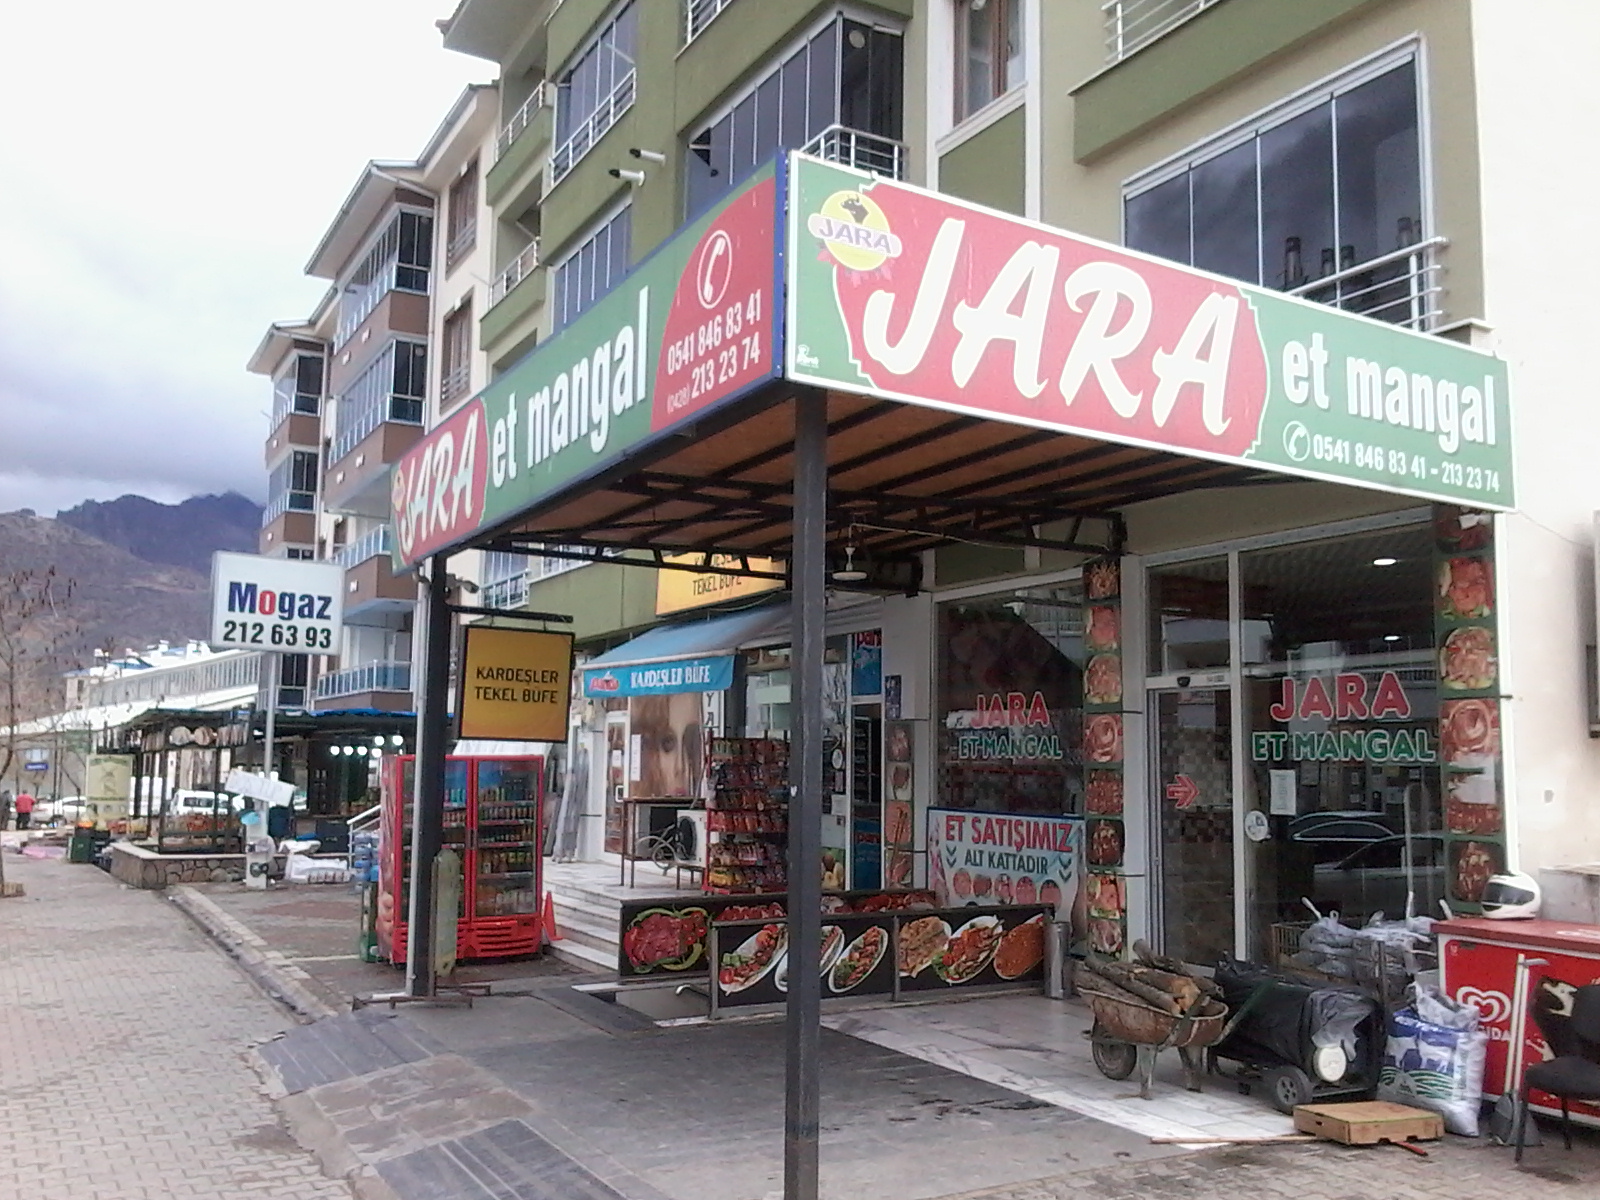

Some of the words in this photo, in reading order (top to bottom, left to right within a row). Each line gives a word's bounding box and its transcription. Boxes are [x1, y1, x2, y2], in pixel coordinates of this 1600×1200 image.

[819, 218, 892, 254] JARA
[668, 332, 695, 375] 0541
[698, 314, 722, 357] 846
[725, 301, 742, 339] 83
[746, 288, 761, 325] 41
[862, 217, 1240, 436] JARA
[1282, 332, 1330, 410] et
[1346, 356, 1497, 454] mangal
[691, 358, 715, 399] 213
[719, 345, 737, 384] 23
[741, 331, 760, 370] 74
[401, 408, 479, 556] JARA
[492, 390, 518, 488] et
[527, 285, 649, 470] mangal
[1313, 434, 1350, 465] 0541
[1355, 442, 1384, 471] 846
[1388, 449, 1407, 475] 83
[1411, 455, 1426, 480] 41
[1441, 461, 1463, 486] 213
[1466, 466, 1482, 490] 23
[1485, 469, 1500, 493] 74
[228, 581, 333, 621] Mogaz
[223, 620, 264, 645] 212
[271, 623, 298, 646] 63
[305, 626, 331, 649] 93
[476, 666, 559, 685] KARDEŞLER
[475, 686, 517, 702] TEKEL
[522, 687, 558, 704] BÜFE
[971, 691, 1050, 729] JARA
[1270, 671, 1411, 722] JARA
[958, 736, 979, 760] ET
[981, 735, 1063, 760] MANGAL
[1252, 731, 1287, 761] ET
[1292, 729, 1436, 762] MANGAL
[945, 815, 965, 842] ET
[971, 816, 1073, 852] SATIŞIMIZ
[964, 849, 984, 867] ALT
[988, 851, 1049, 875] KATTADIR
